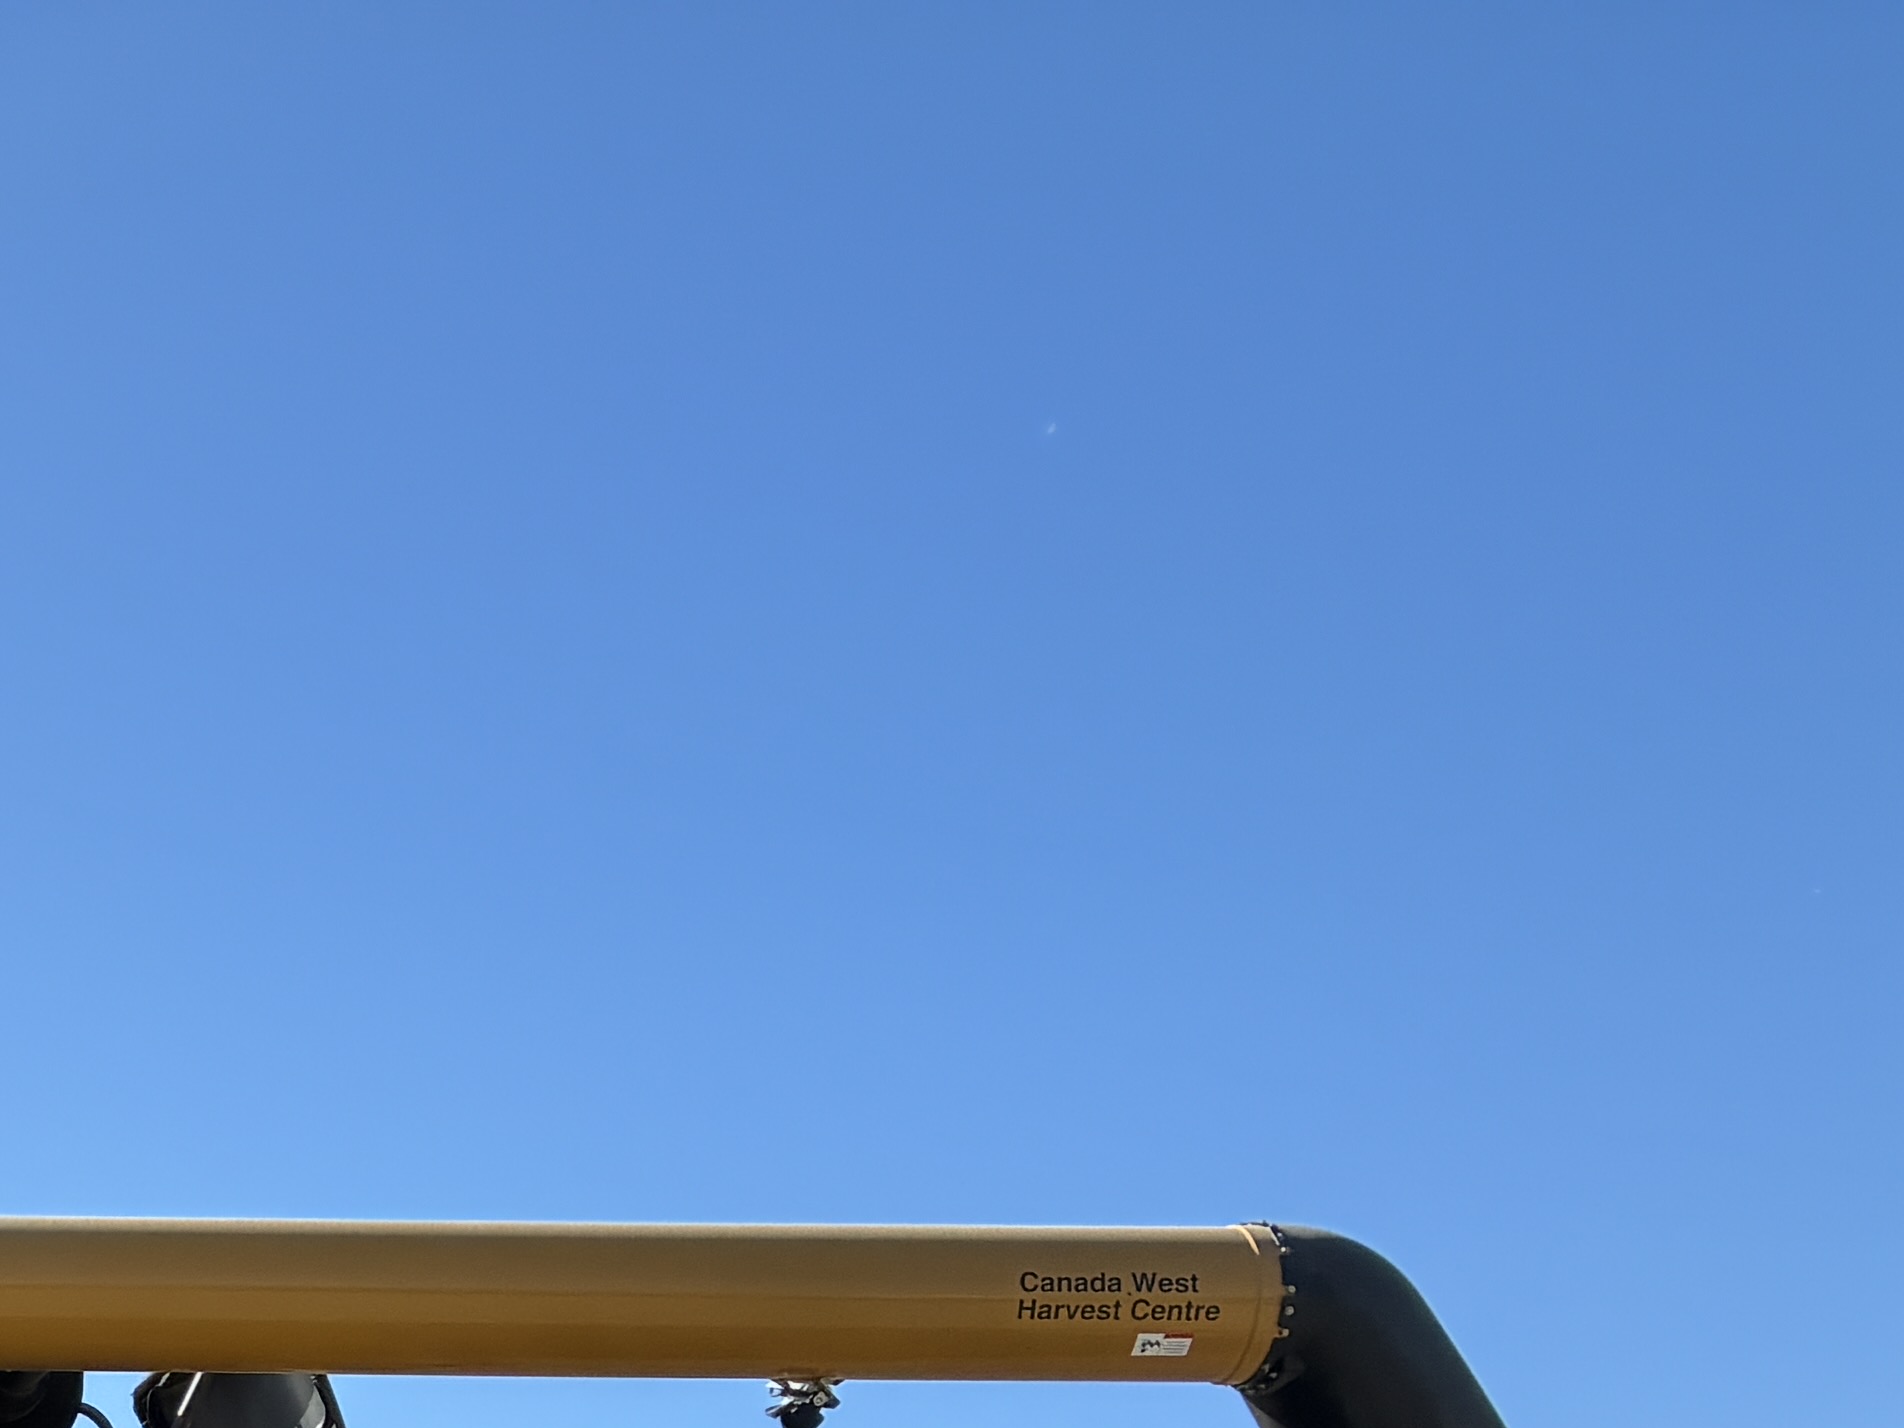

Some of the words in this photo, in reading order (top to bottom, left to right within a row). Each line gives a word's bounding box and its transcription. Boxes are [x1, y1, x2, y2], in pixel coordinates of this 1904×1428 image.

[1019, 1271, 1122, 1293] Canada
[1131, 1271, 1200, 1293] West
[1017, 1299, 1122, 1320] Harvest
[1130, 1299, 1221, 1322] Centre
